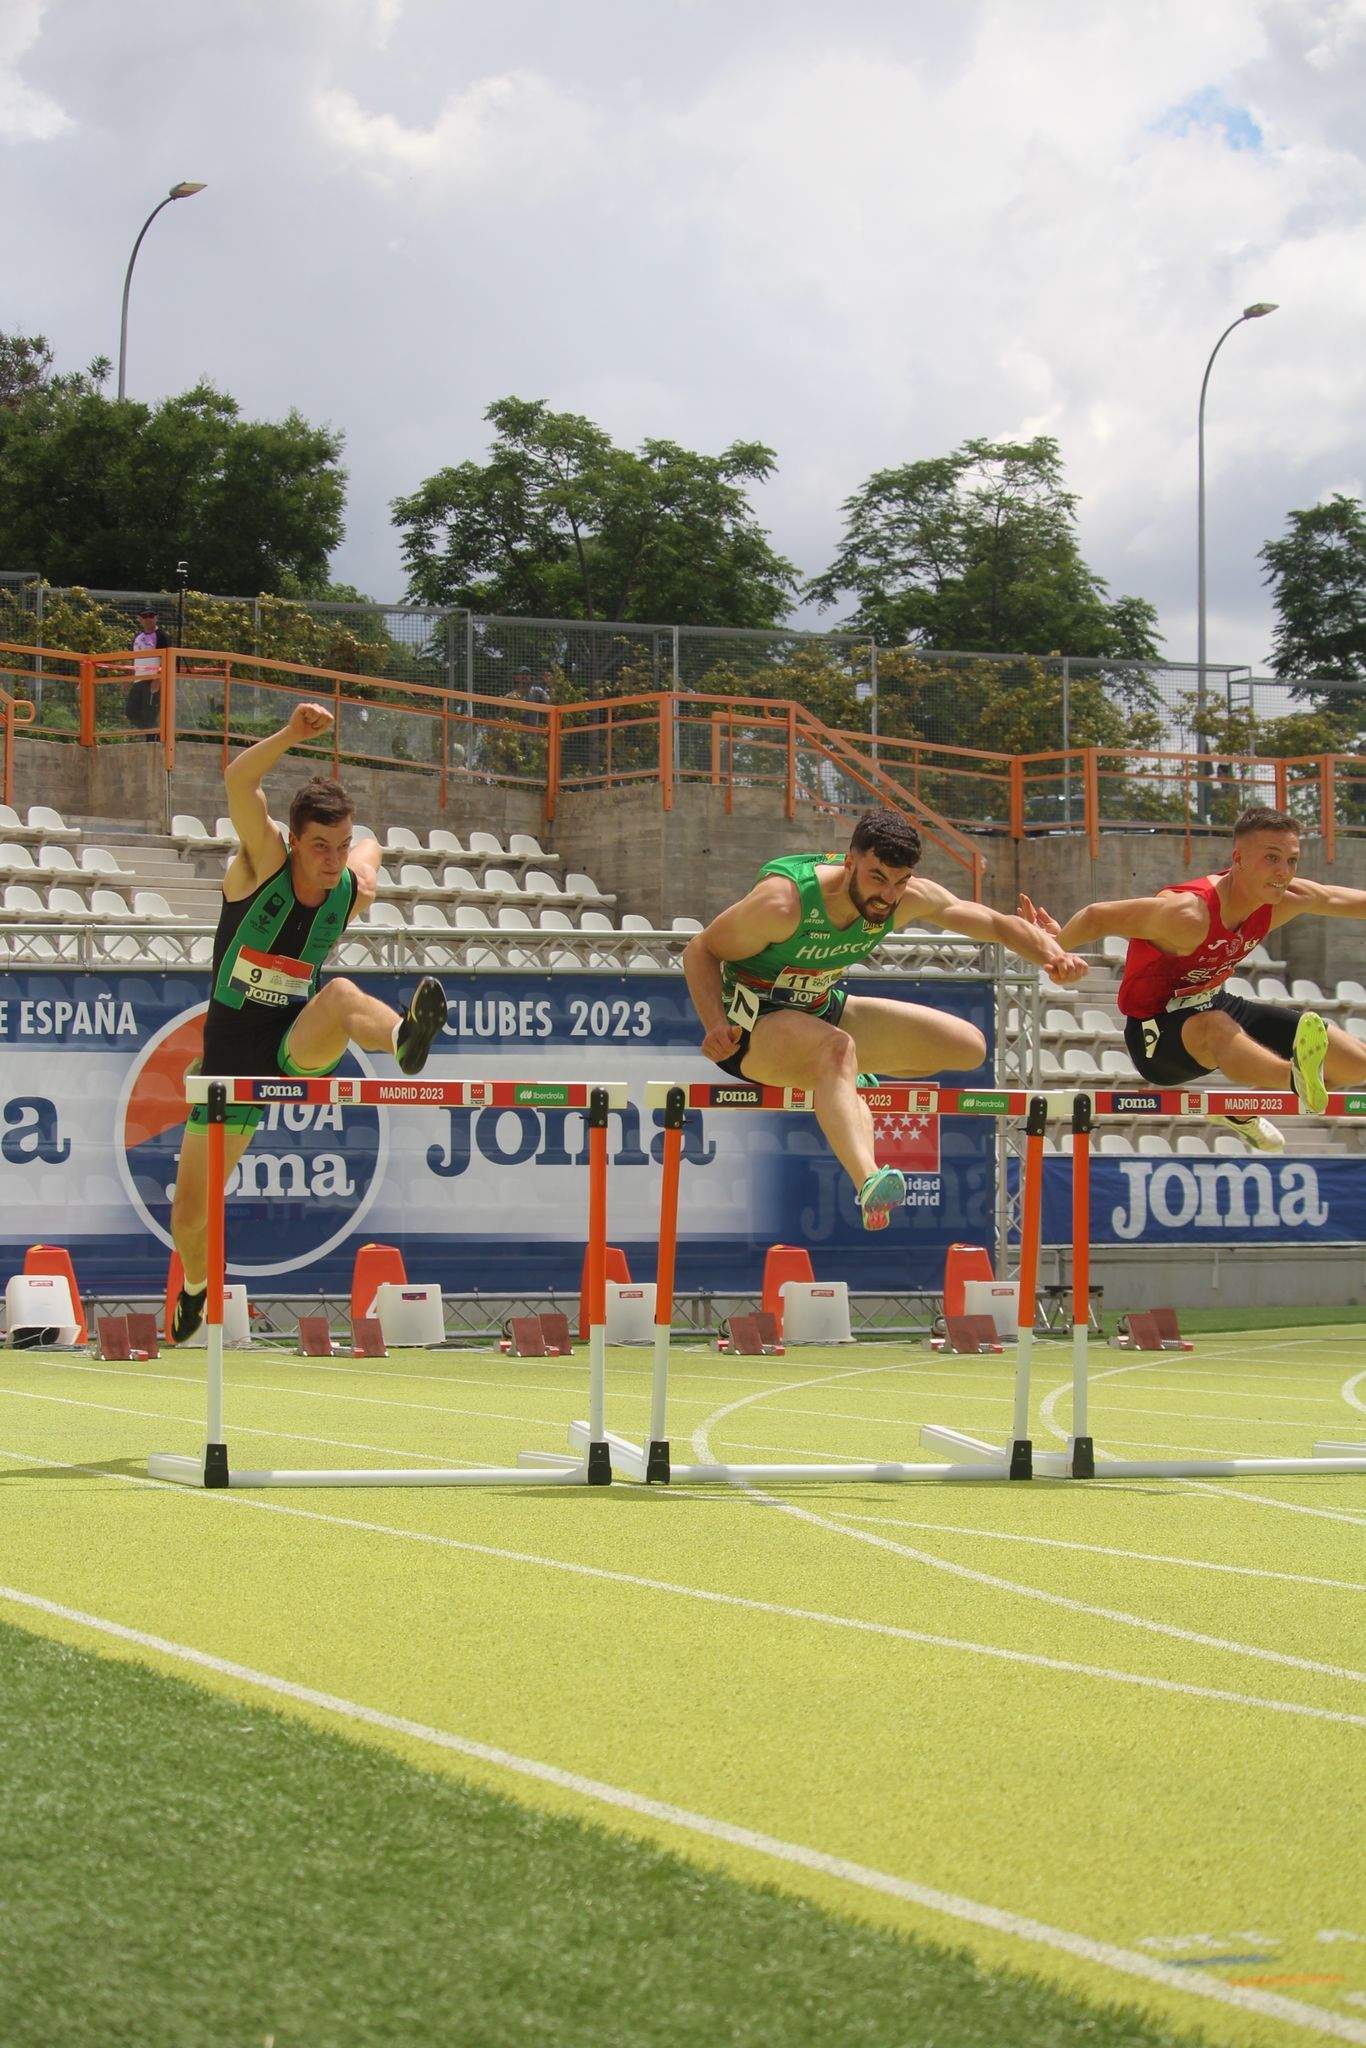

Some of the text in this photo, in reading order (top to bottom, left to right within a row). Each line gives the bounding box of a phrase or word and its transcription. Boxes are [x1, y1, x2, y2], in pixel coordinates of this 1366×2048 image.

[249, 968, 262, 983] 9
[788, 975, 810, 989] 11
[733, 989, 755, 1019] 7
[20, 993, 138, 1035] ESPAÑA
[441, 1000, 651, 1037] CLUBES 2023
[258, 1084, 304, 1098] Joma
[379, 1086, 444, 1100] MADRID 2023
[716, 1089, 759, 1104] Joma
[868, 1094, 892, 1107] 2023
[1117, 1097, 1158, 1111] Joma
[1224, 1098, 1283, 1111] MADRID 2023
[256, 1104, 344, 1132] IGA
[1112, 1162, 1329, 1240] Joma
